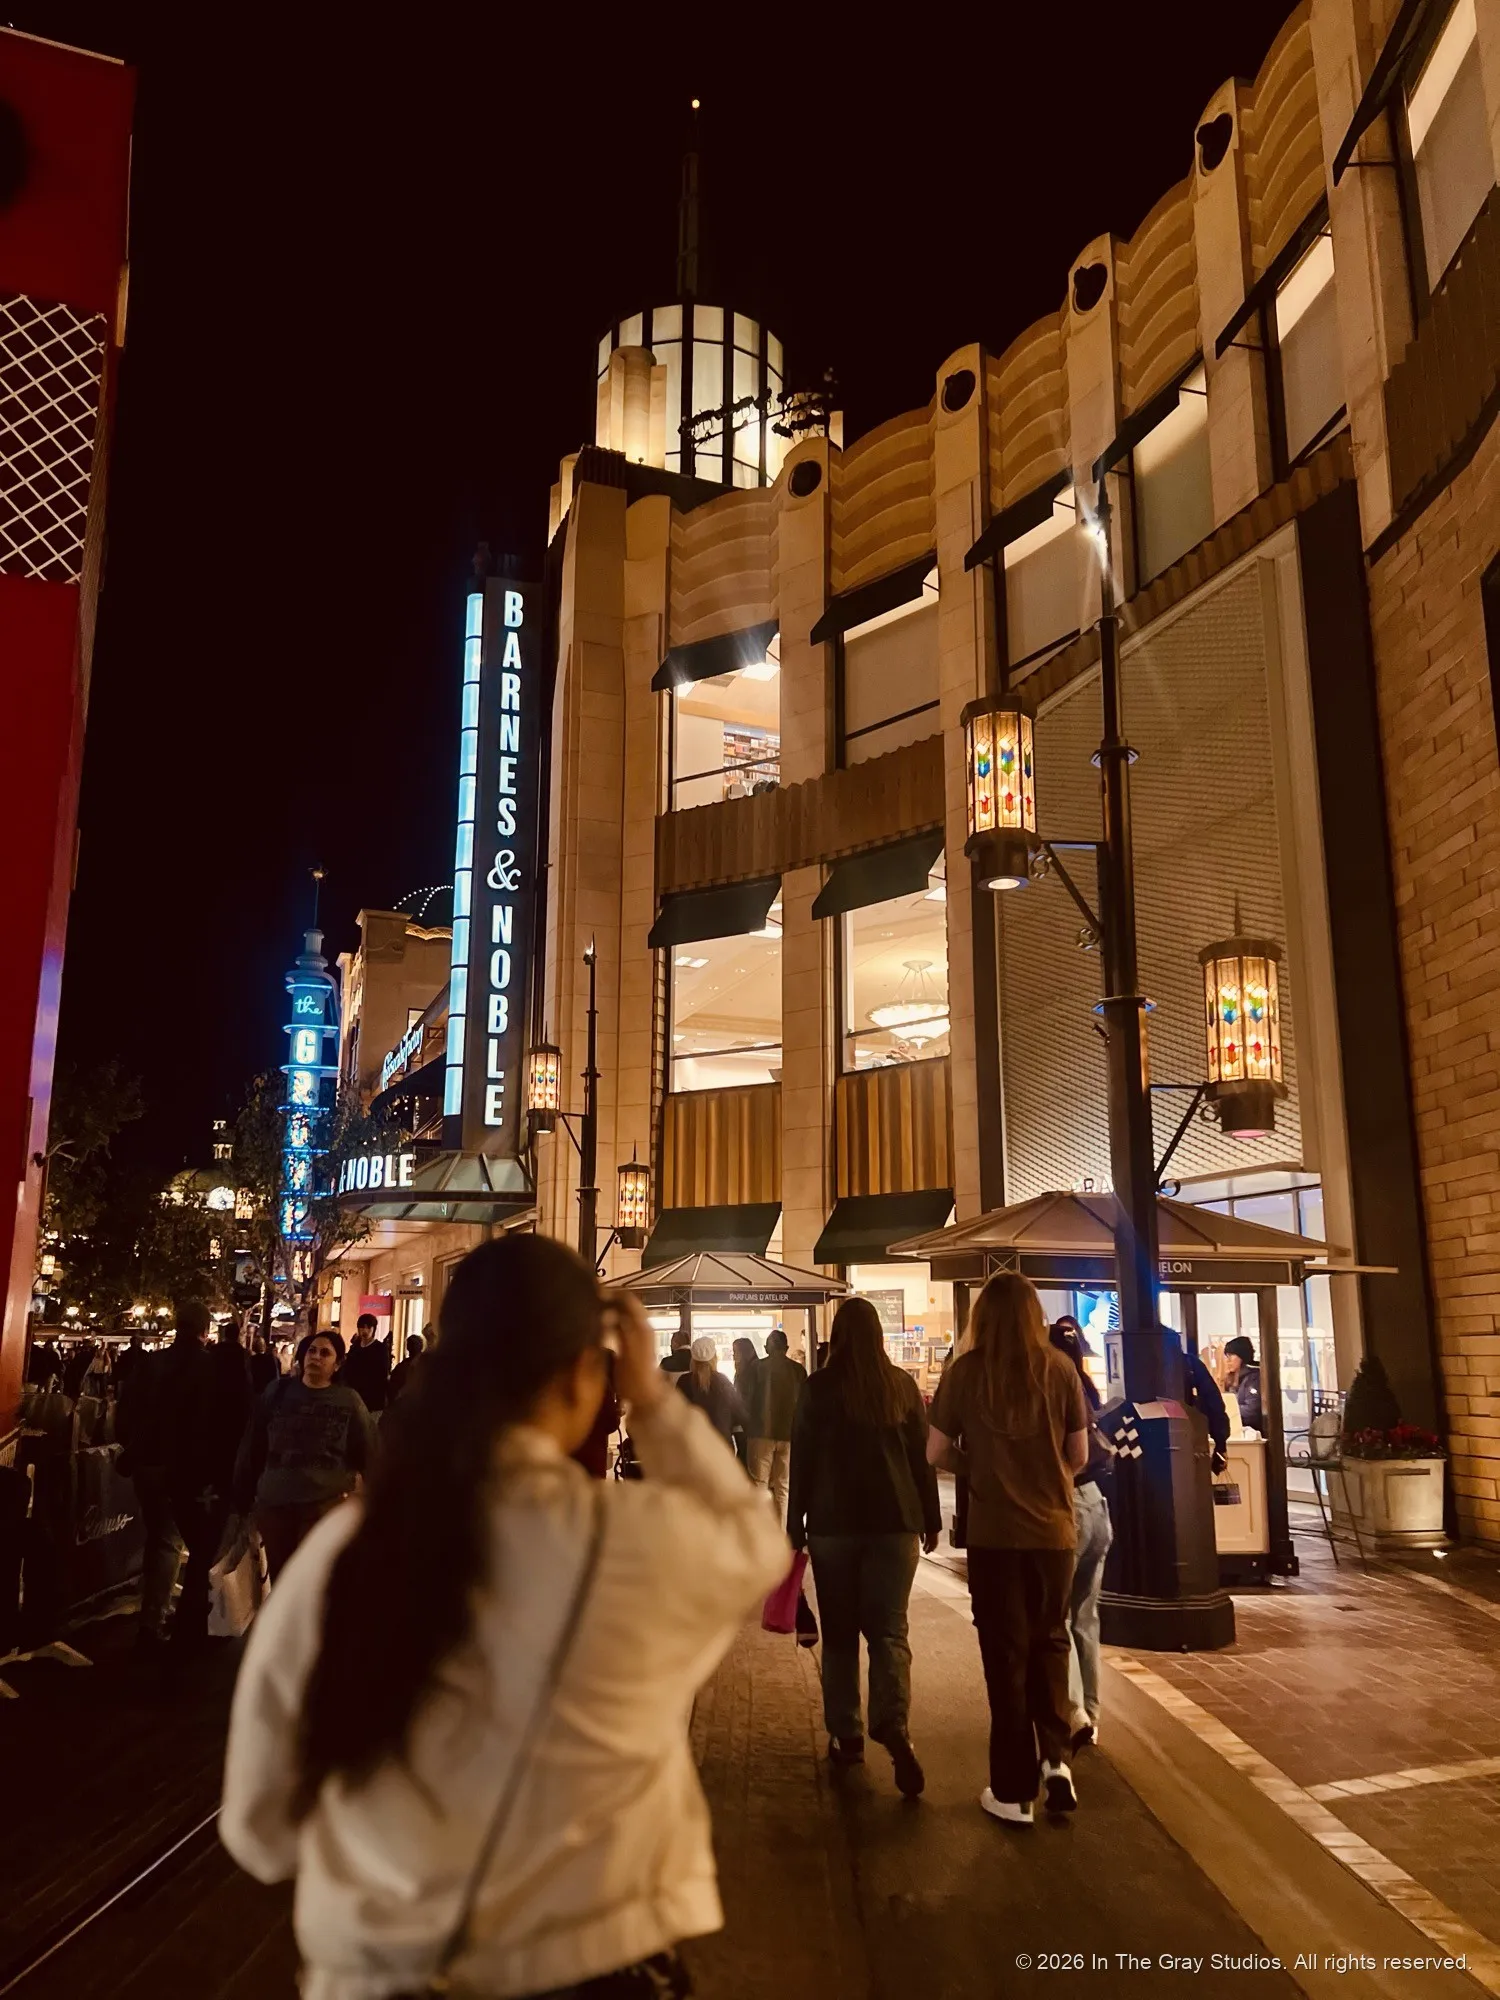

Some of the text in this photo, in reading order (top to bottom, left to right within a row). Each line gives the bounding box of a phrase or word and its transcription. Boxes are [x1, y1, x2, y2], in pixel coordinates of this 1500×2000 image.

[484, 590, 524, 1126] BARNES & NOBLE
[295, 996, 323, 1014] the
[346, 1154, 415, 1191] NOBLE
[730, 1293, 790, 1301] PARFUMS D'ATELIER
